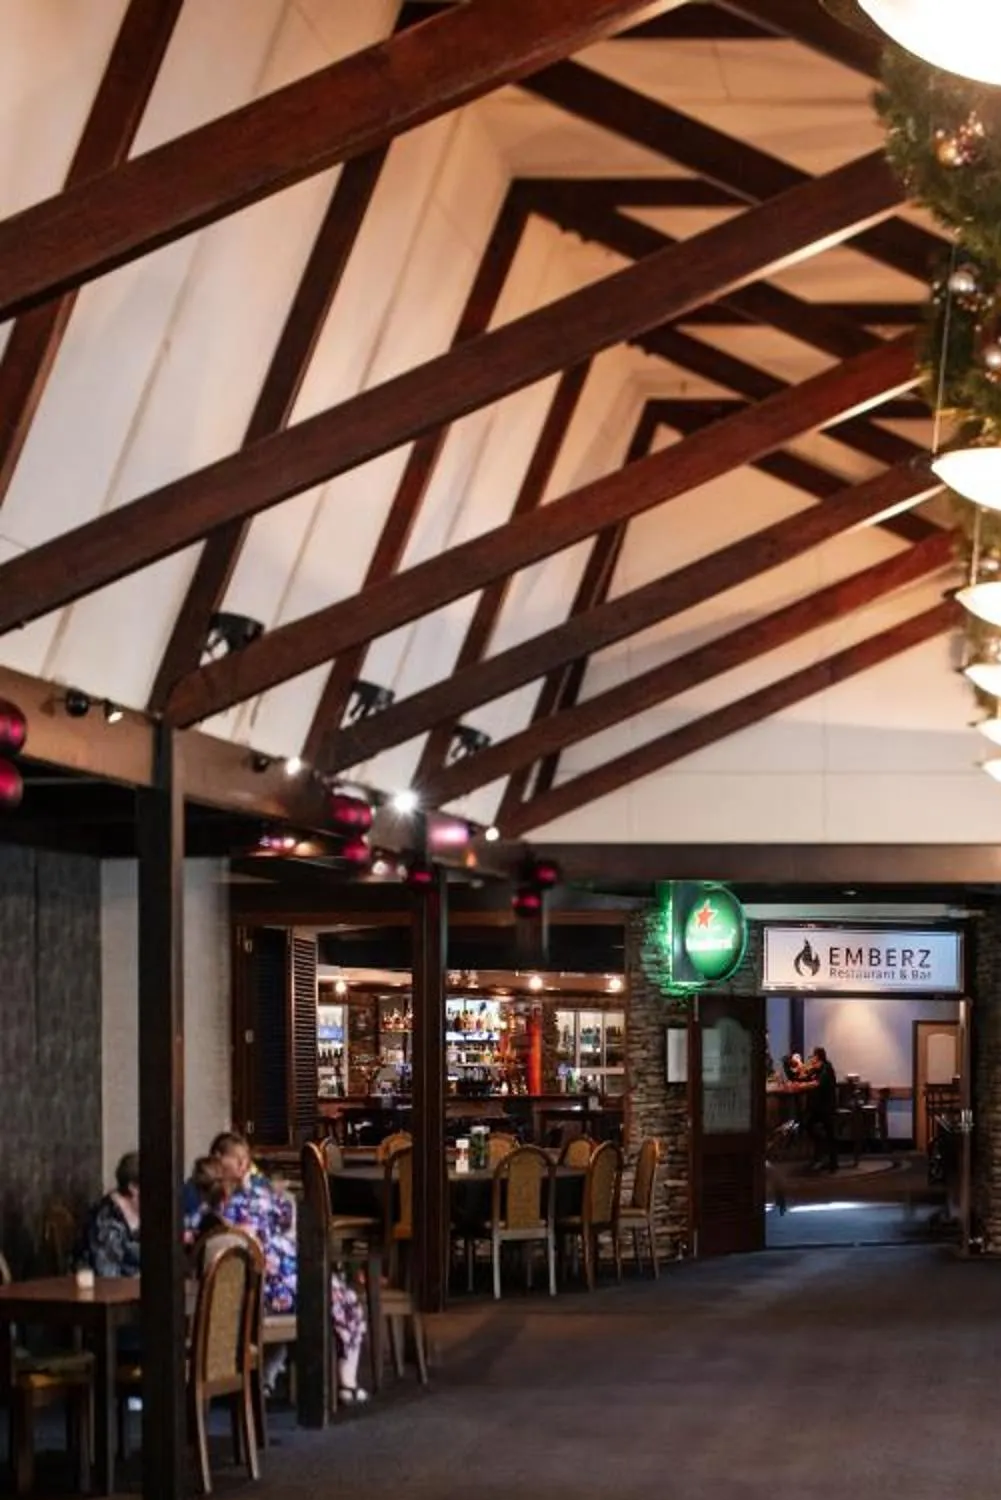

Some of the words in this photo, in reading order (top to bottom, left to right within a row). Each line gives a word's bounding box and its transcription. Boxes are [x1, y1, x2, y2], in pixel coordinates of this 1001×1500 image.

[829, 946, 931, 969] EMBERZ
[829, 968, 895, 980] Restaurant
[899, 969, 907, 980] &
[911, 970, 932, 980] Bar
